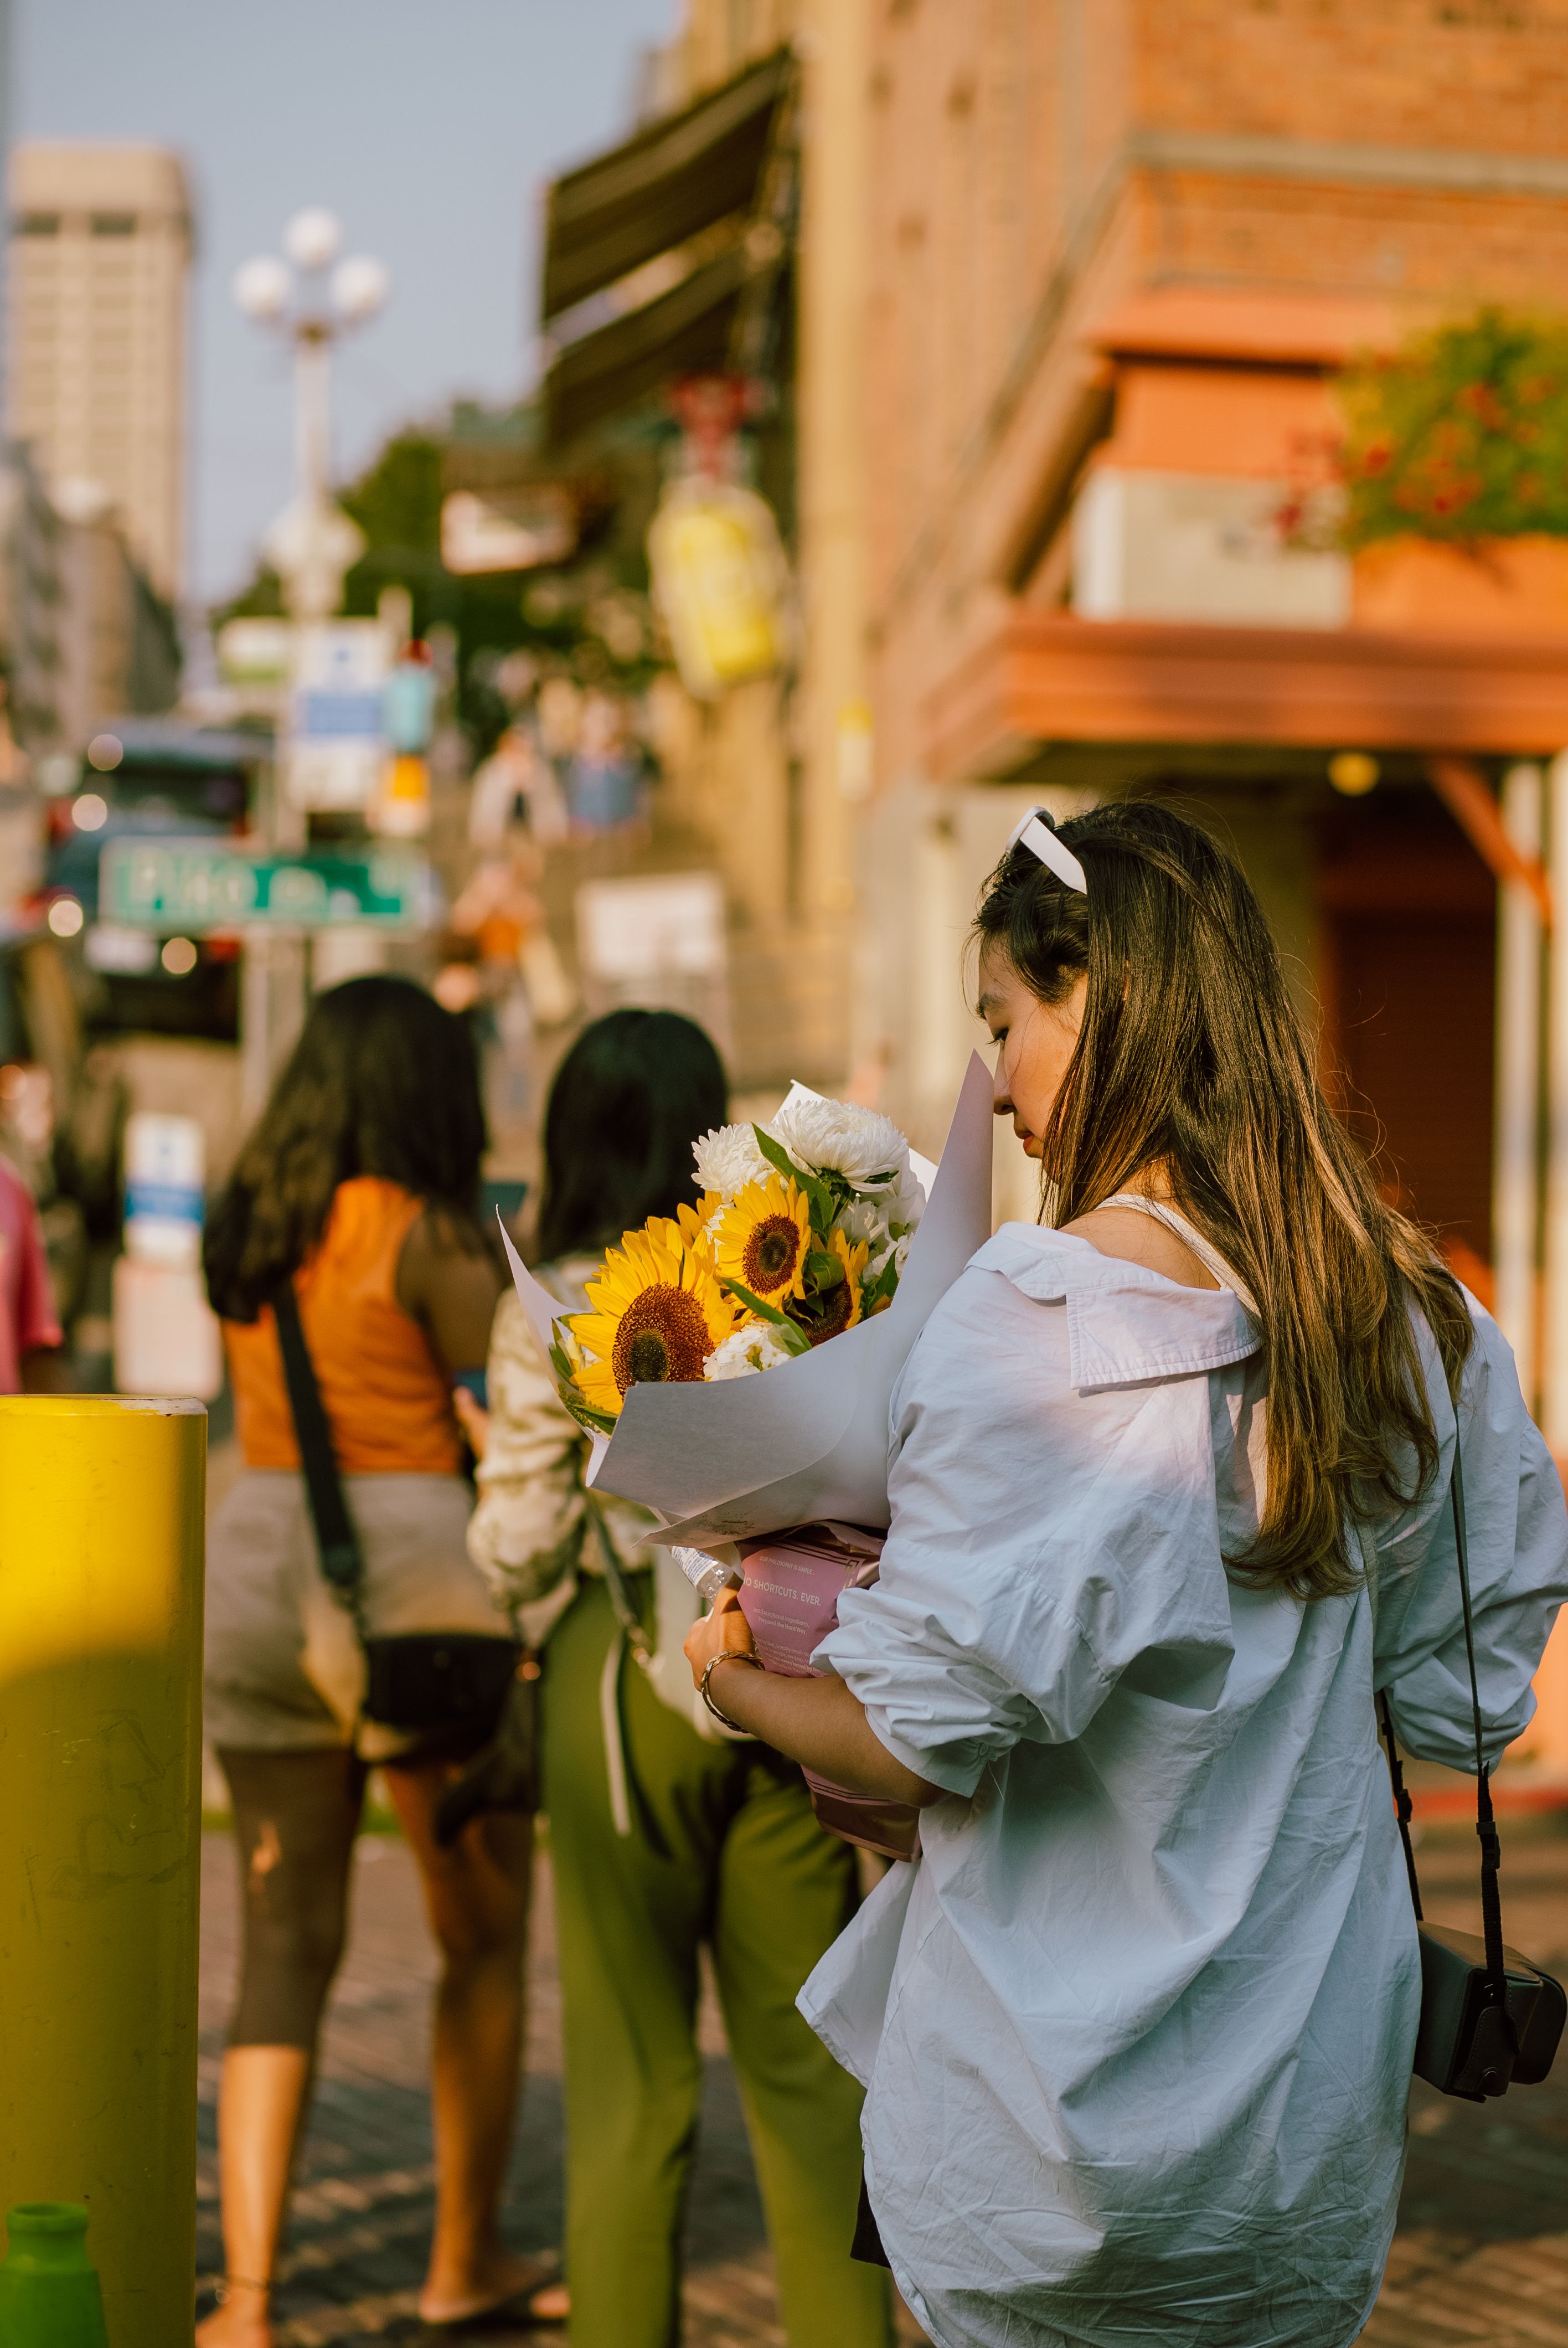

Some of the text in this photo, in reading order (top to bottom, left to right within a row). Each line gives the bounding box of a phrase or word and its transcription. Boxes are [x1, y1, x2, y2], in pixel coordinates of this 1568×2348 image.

[768, 1558, 793, 1569] PHILOSOPHY
[754, 1579, 798, 1600] SHORTCUTS.
[801, 1592, 821, 1606] EVER.
[761, 1609, 785, 1620] Exceptional
[758, 1616, 777, 1626] Prepared
[785, 1623, 796, 1632] Hard
[796, 1627, 807, 1635] Way.
